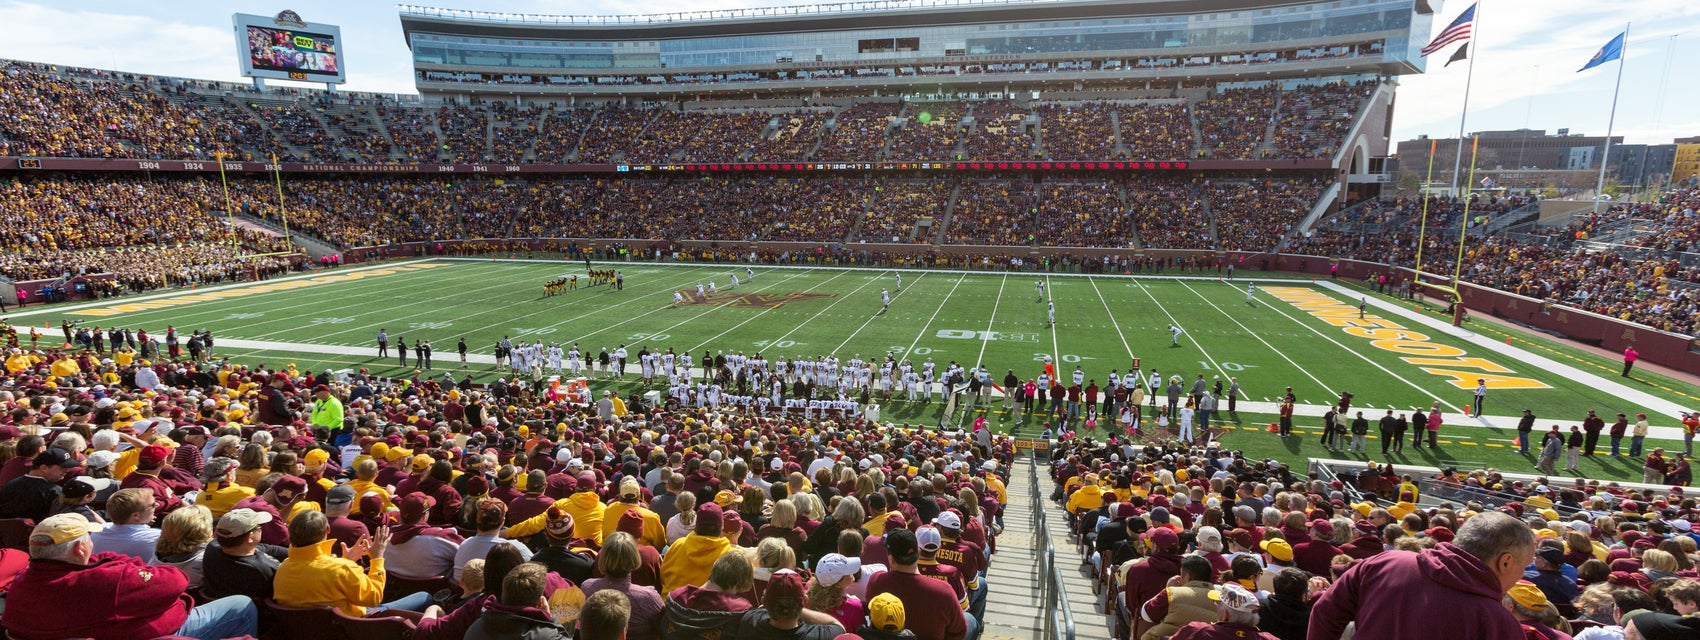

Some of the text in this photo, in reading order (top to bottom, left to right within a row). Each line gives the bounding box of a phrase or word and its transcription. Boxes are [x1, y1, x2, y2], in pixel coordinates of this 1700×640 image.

[24, 160, 37, 168] 25
[139, 161, 161, 170] 1904
[183, 162, 204, 170] 1934
[225, 163, 243, 171] 1935
[350, 164, 420, 172] CHAMPIONSHIPS
[627, 333, 671, 341] 50
[1255, 285, 1555, 390] MINNESOTA
[752, 339, 796, 348] 40
[886, 345, 933, 355] 30
[1033, 352, 1081, 363] 20
[1199, 360, 1246, 372] 10
